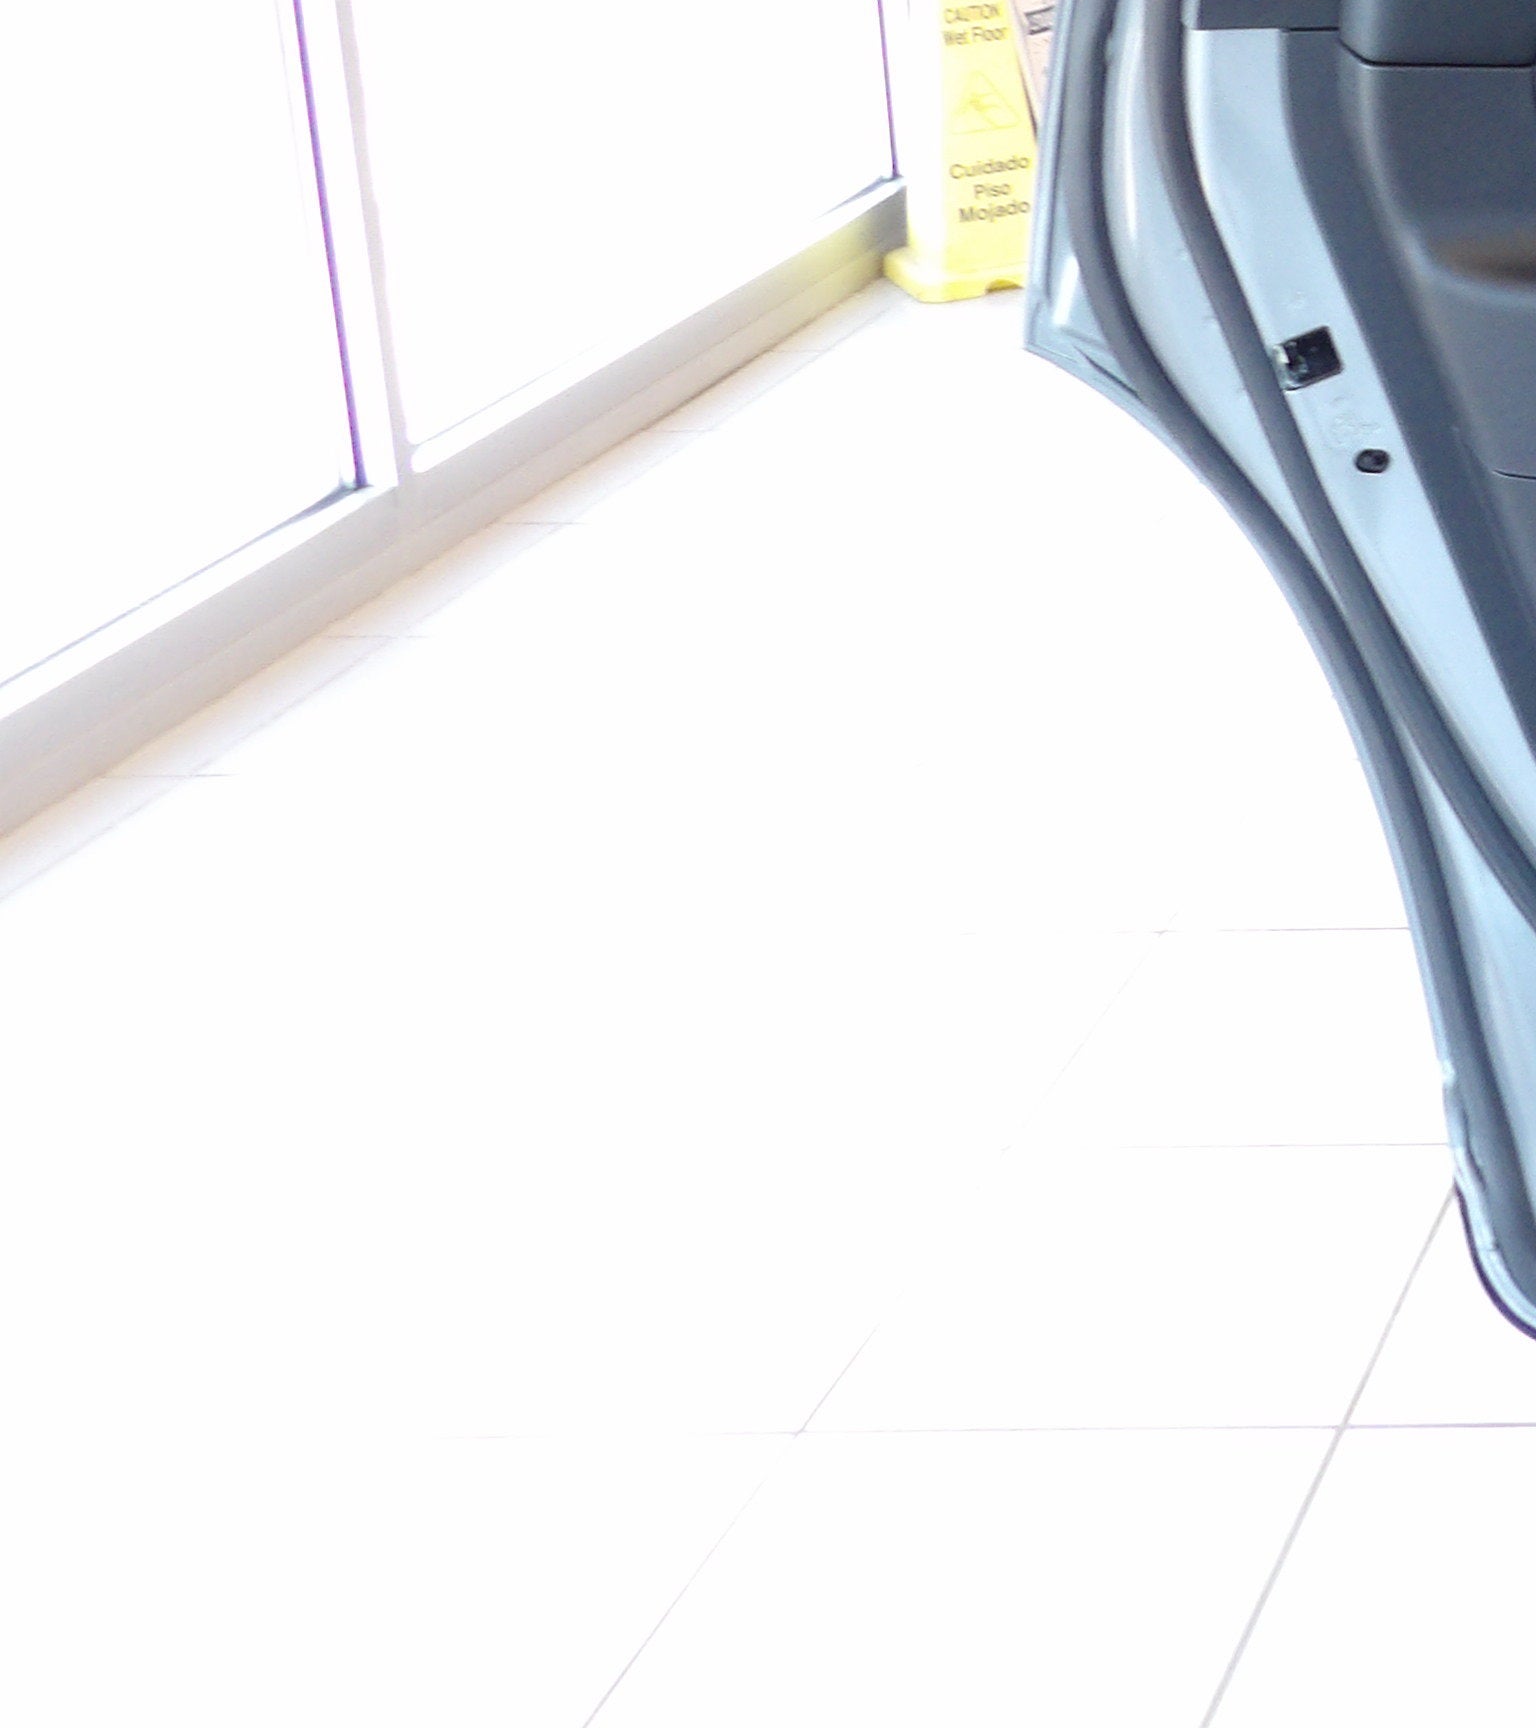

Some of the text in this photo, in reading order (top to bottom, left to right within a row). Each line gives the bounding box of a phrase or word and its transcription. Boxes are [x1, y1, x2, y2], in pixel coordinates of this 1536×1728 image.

[943, 4, 1000, 24] CAUTION
[972, 26, 1007, 43] Floor
[949, 155, 1030, 180] Cuidado
[973, 183, 1011, 200] Piso
[959, 199, 1031, 224] Mojado
